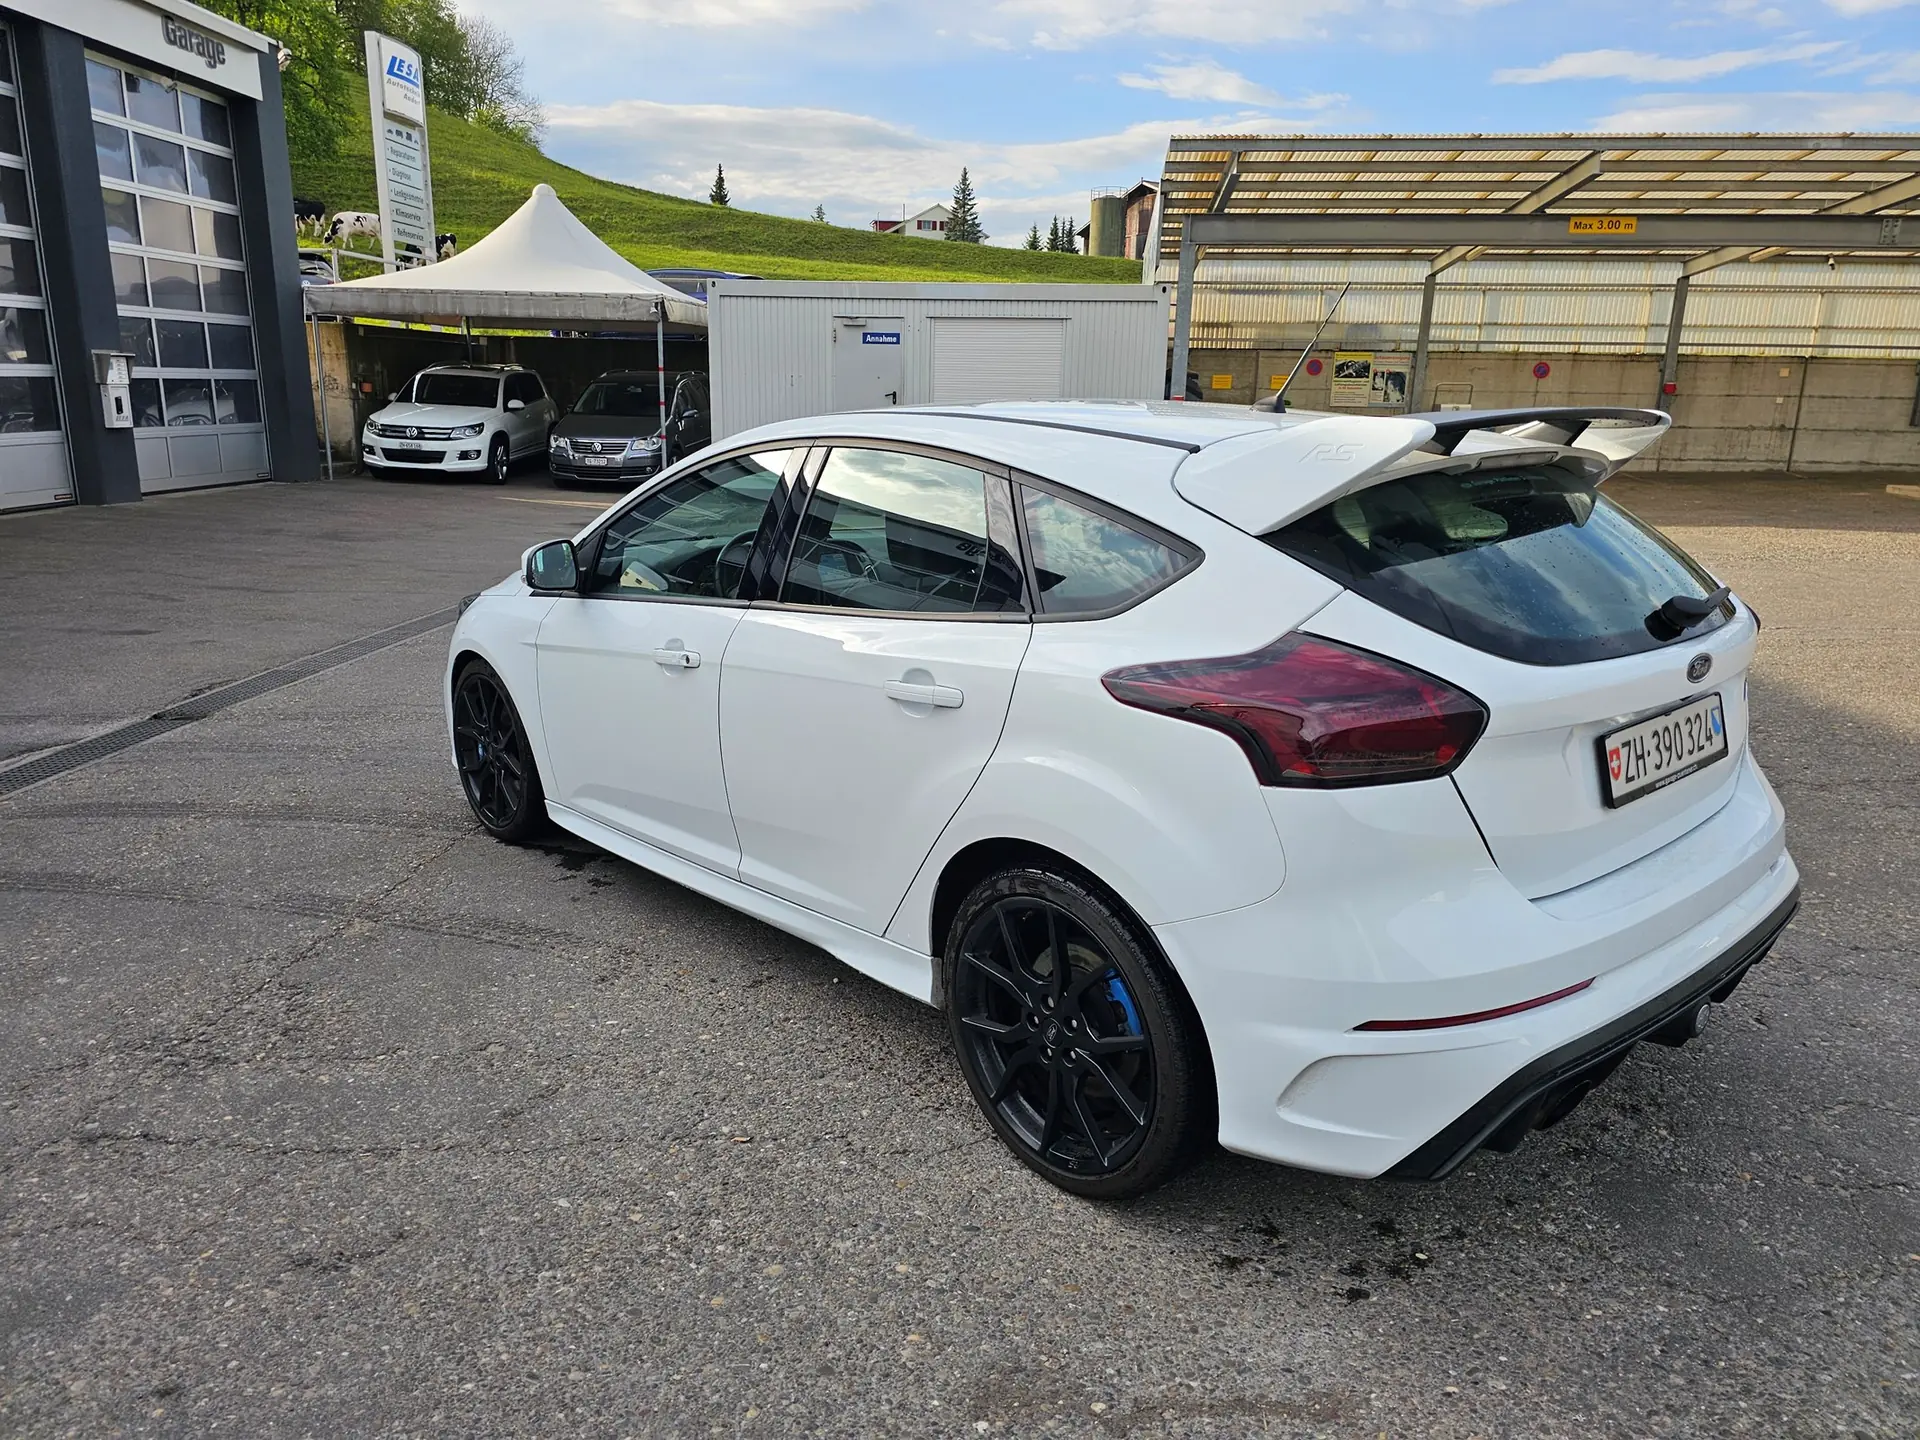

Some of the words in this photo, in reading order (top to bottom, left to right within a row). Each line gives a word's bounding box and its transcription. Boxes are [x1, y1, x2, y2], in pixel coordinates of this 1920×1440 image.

[161, 15, 225, 69] Garage
[386, 55, 419, 88] LESA
[390, 147, 416, 162] Reparaturen
[392, 167, 411, 181] Diagnose
[393, 187, 424, 203] Lenkgeometrie
[395, 208, 421, 222] Klimaservice
[1573, 221, 1593, 230] Max
[1597, 219, 1621, 230] 3.00
[1623, 222, 1633, 230] m
[397, 227, 424, 241] Reifenservice
[865, 334, 897, 343] Annahme
